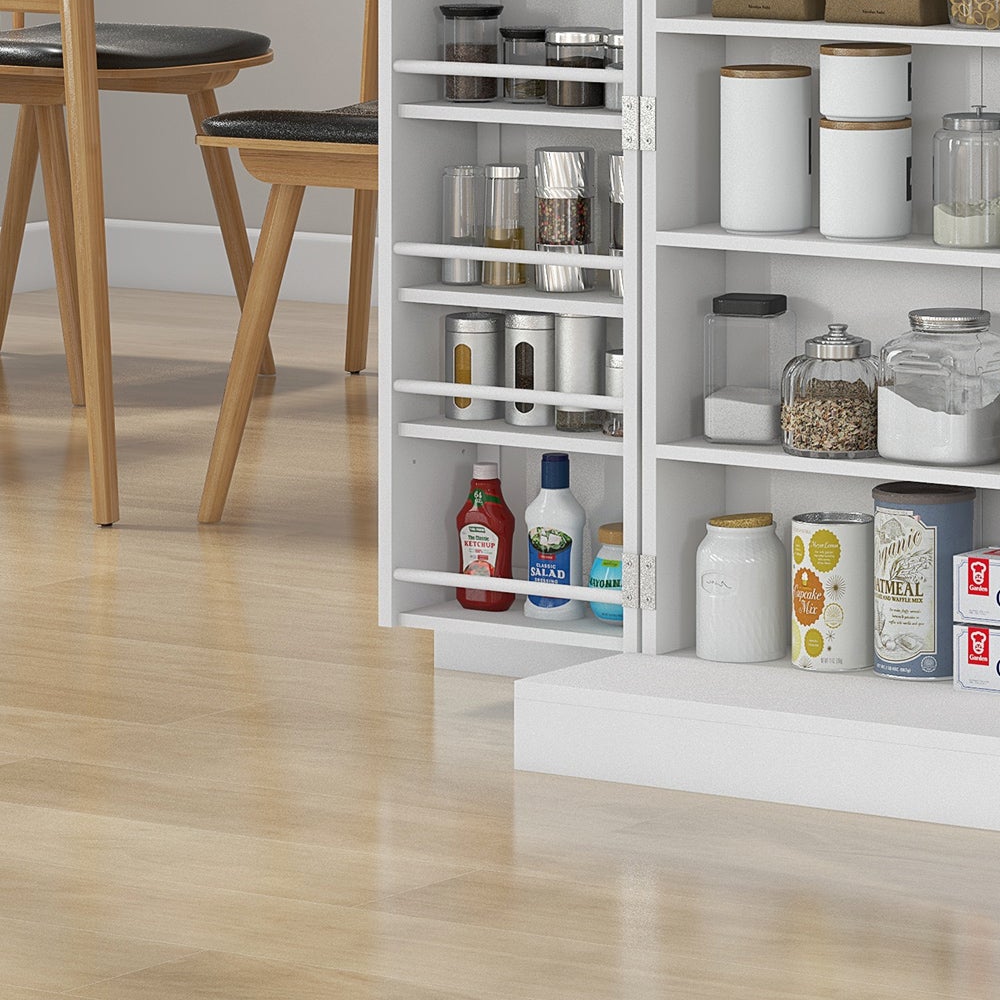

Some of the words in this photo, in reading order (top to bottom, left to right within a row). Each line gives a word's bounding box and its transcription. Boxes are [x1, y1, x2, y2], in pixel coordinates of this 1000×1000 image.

[530, 567, 565, 579] SALAD
[874, 577, 924, 597] ATMEAL
[799, 600, 818, 615] Mix
[969, 654, 988, 662] Garden
